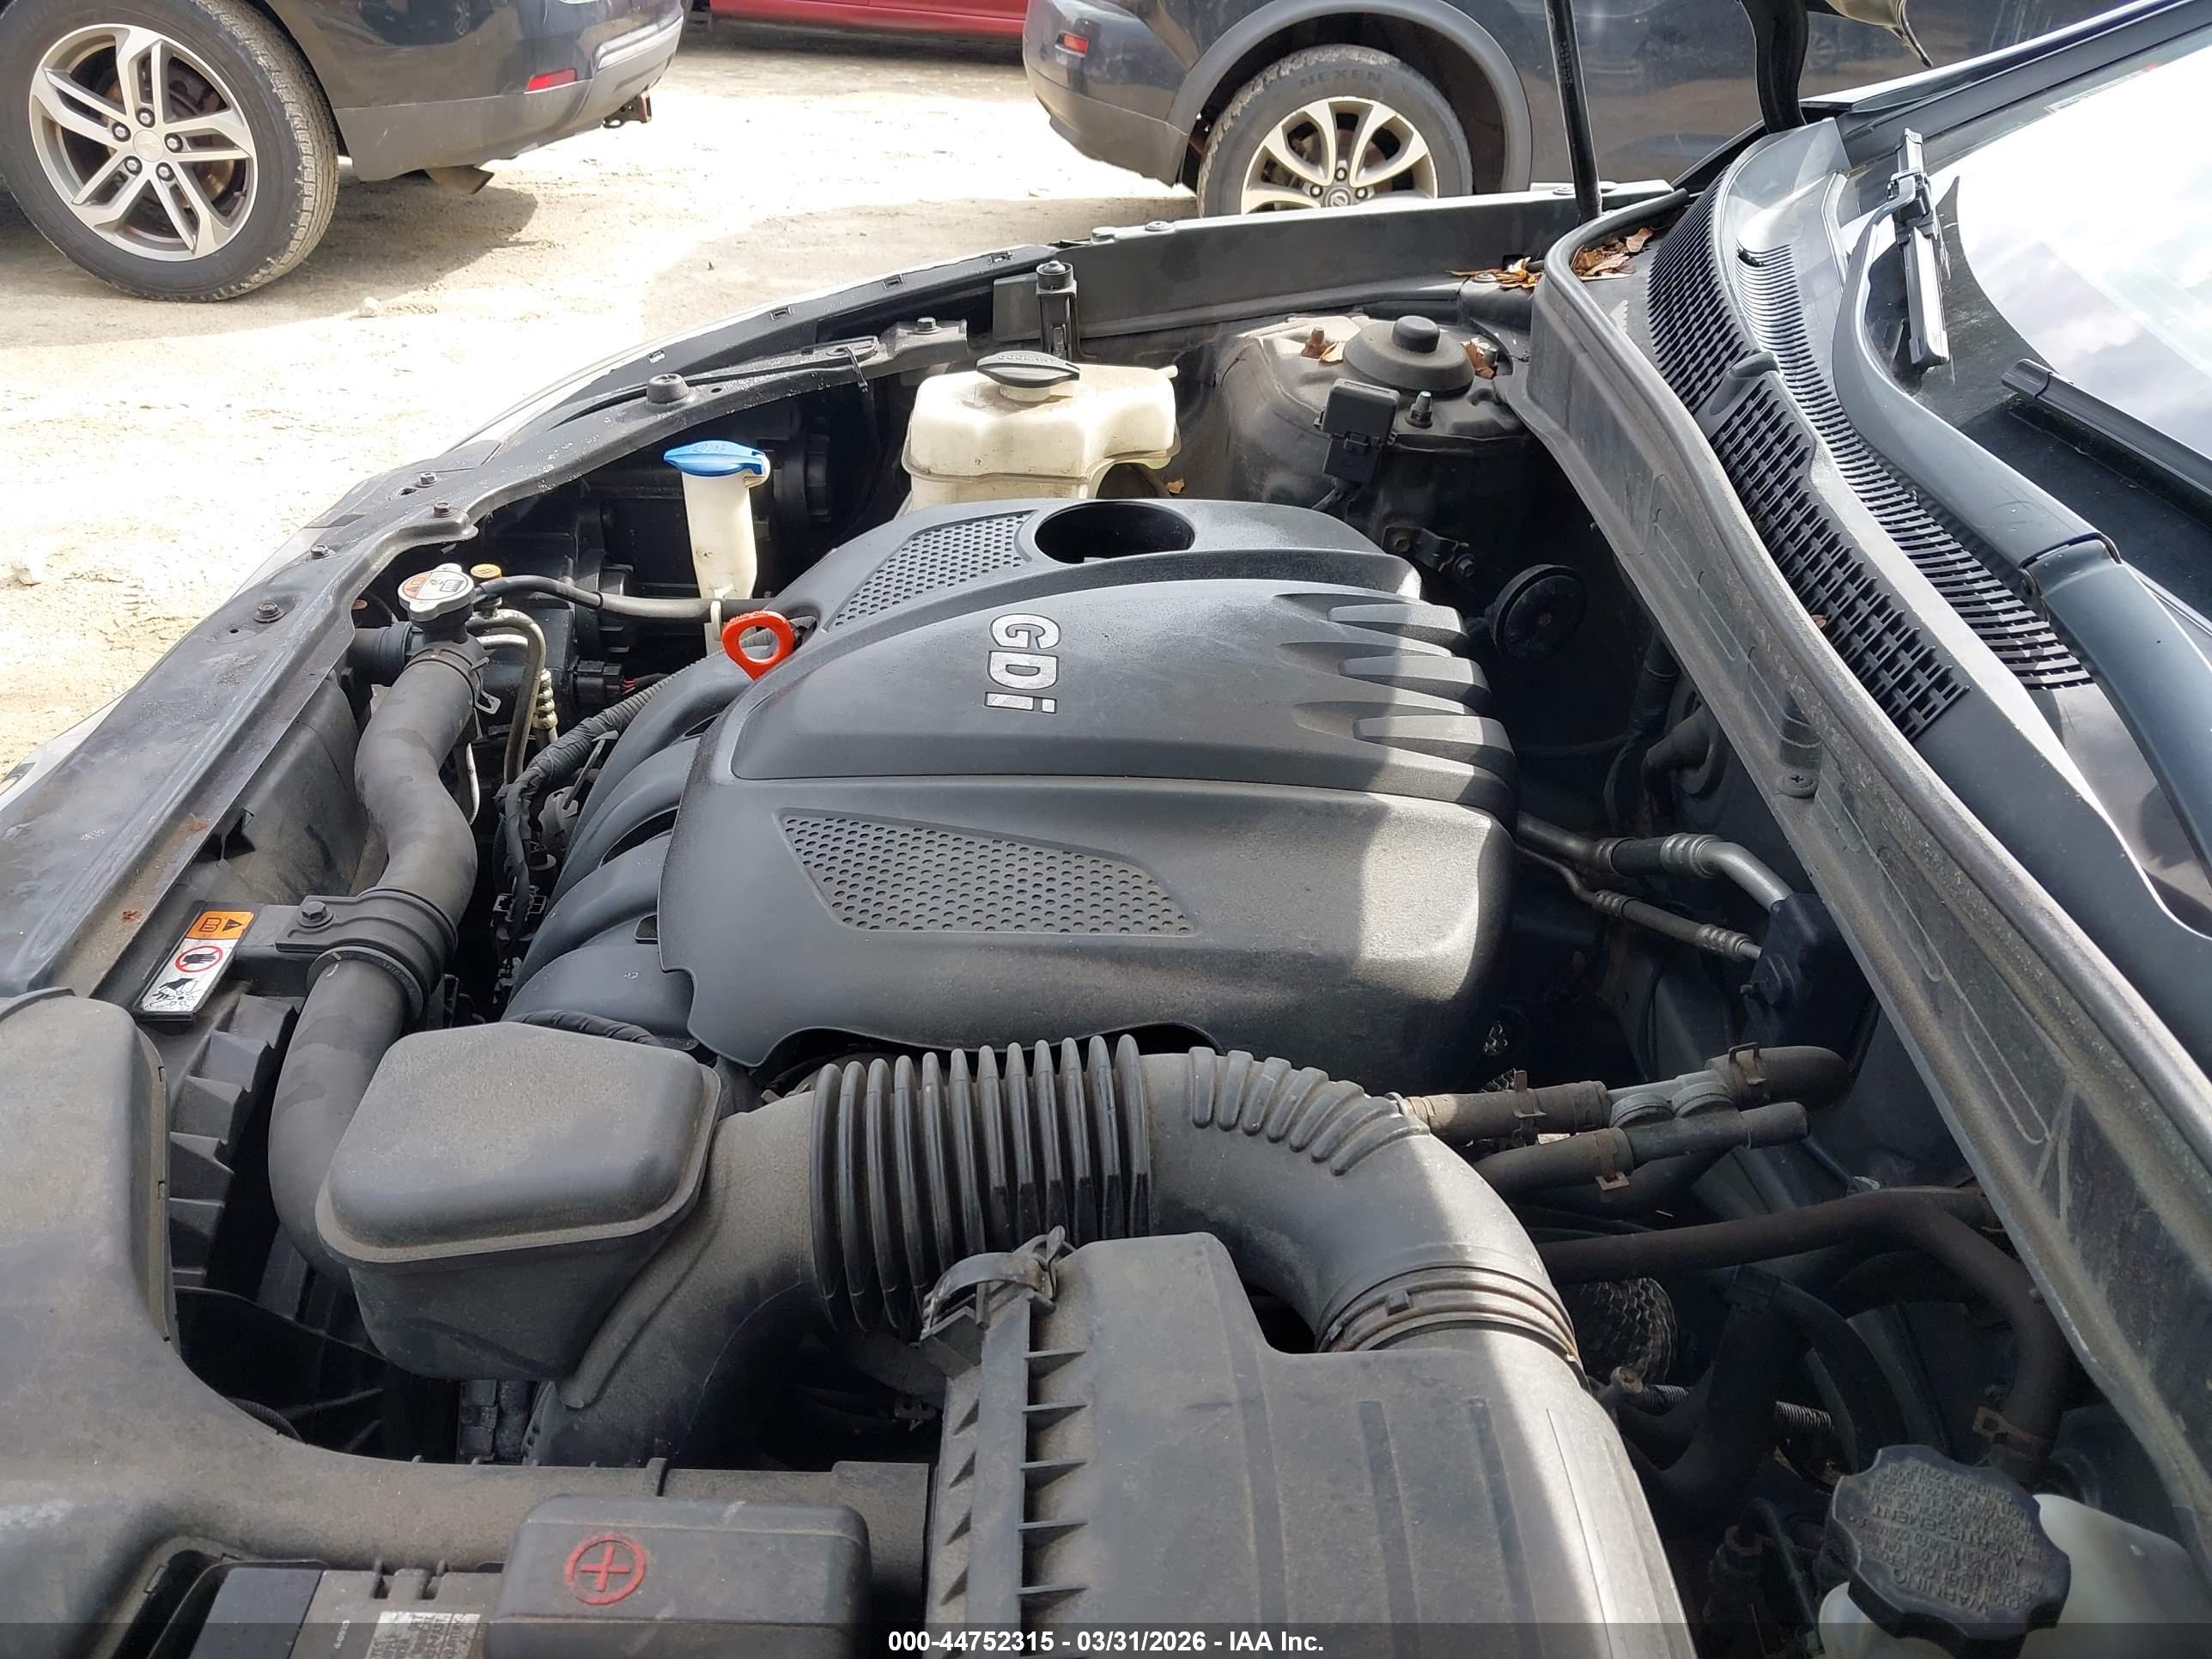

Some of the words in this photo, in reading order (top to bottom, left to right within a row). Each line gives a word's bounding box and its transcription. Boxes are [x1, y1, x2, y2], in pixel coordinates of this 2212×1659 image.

[1300, 70, 1382, 87] NEXEN
[998, 355, 1057, 364] COOLANT
[984, 613, 1061, 714] GDi
[1893, 1569, 1987, 1614] WARNING
